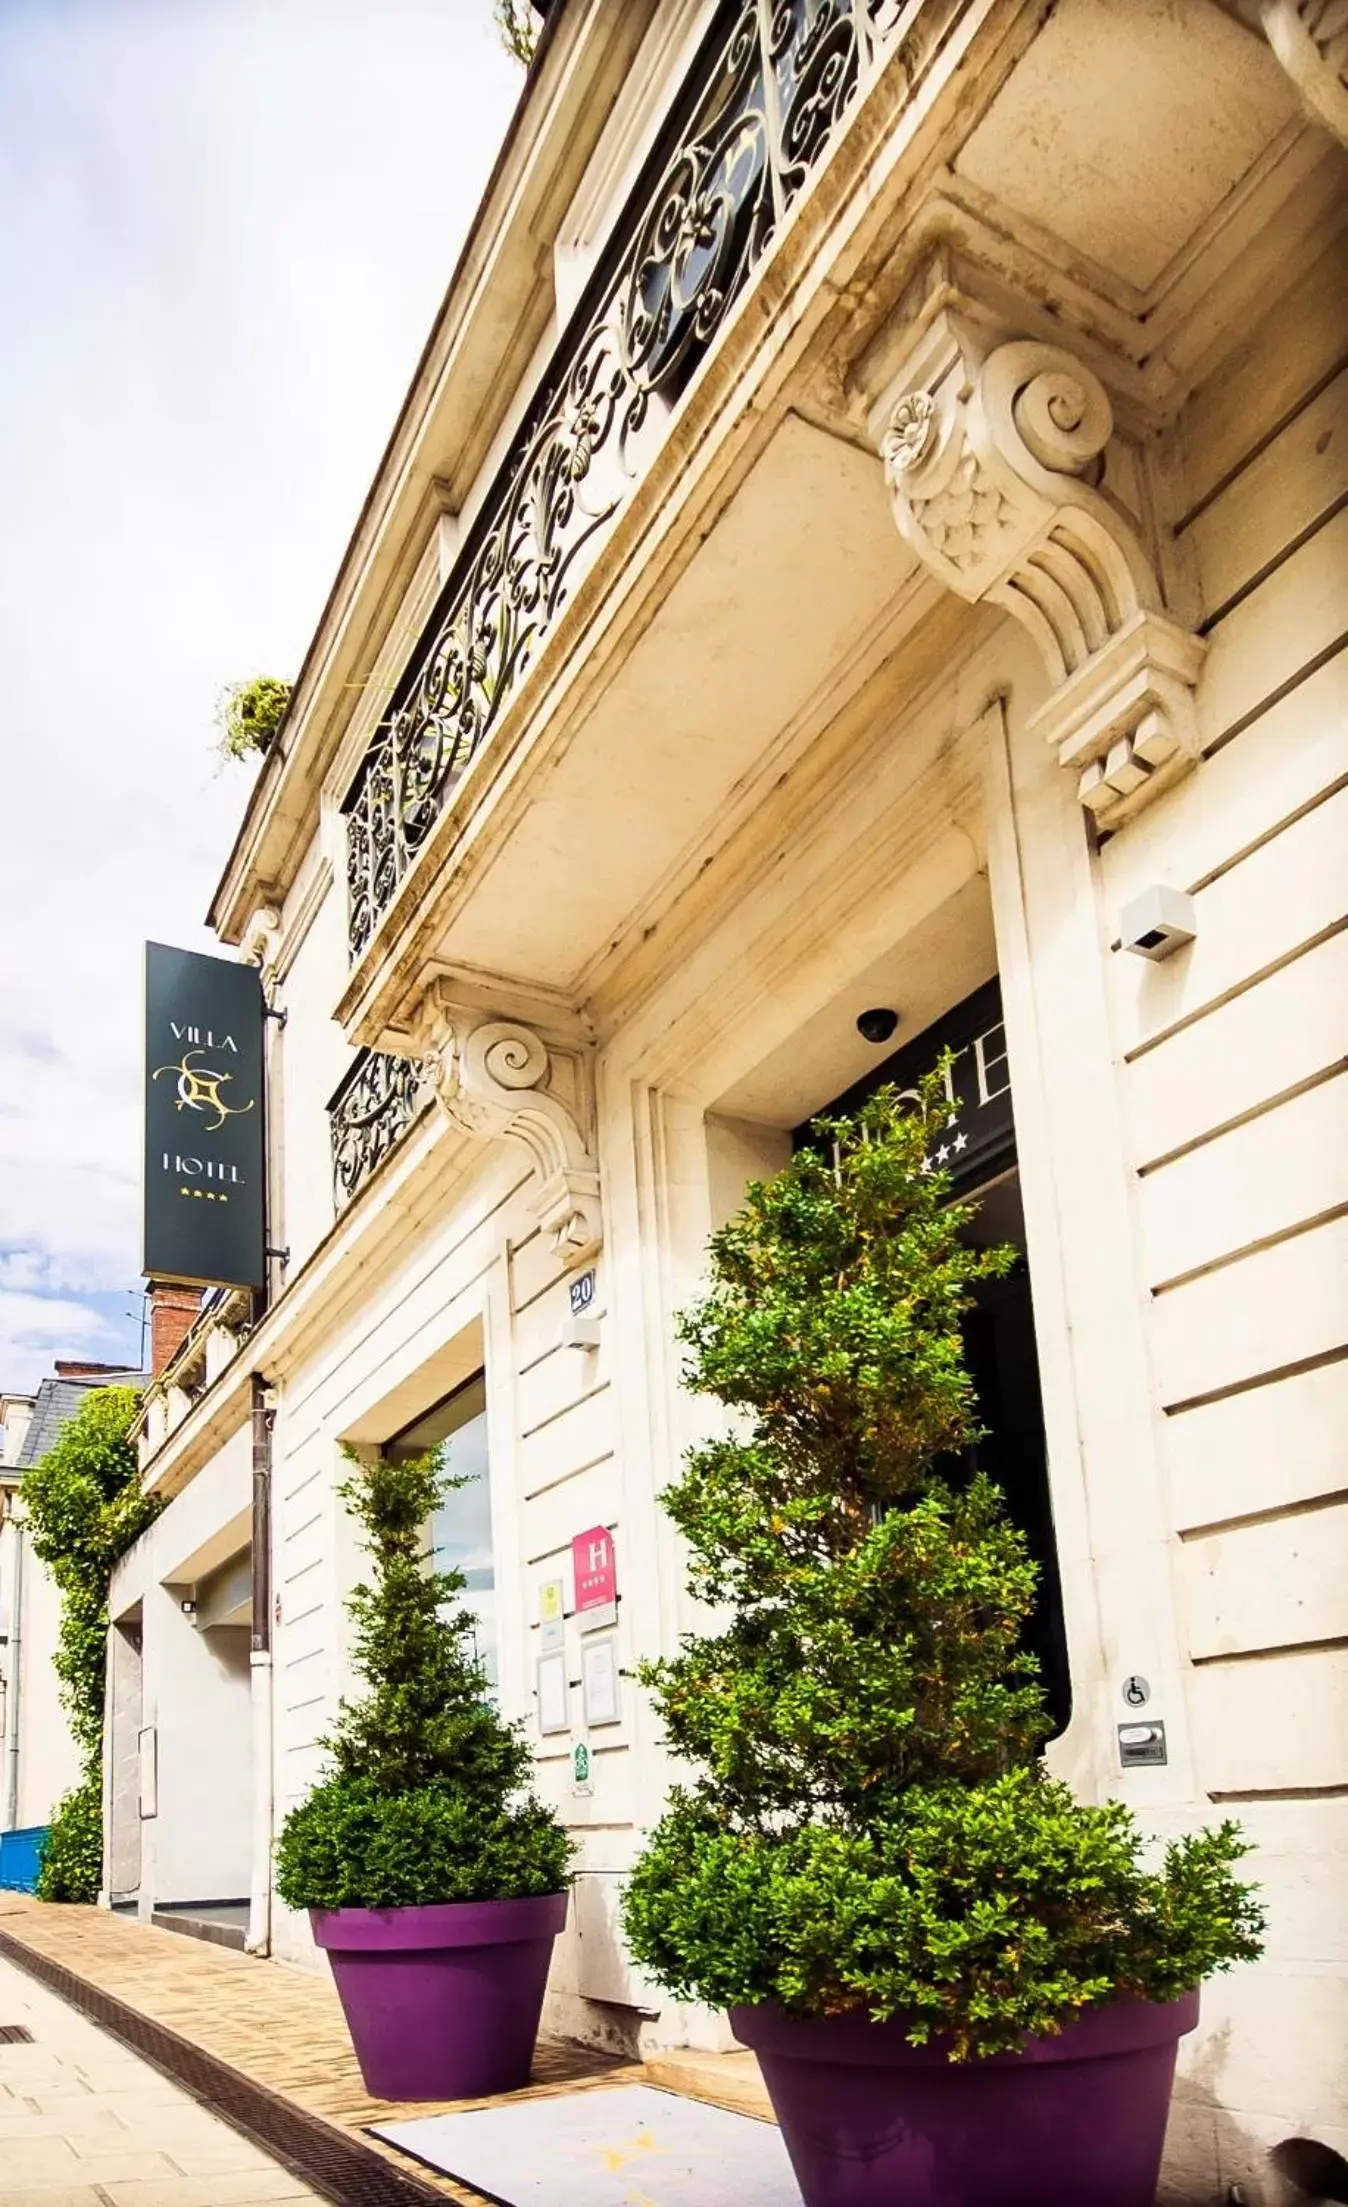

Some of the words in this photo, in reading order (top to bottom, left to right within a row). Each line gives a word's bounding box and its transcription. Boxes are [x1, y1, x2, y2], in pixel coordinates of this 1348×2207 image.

[170, 1021, 238, 1052] VILLA
[163, 1153, 245, 1183] HOTEL
[572, 1278, 591, 1309] 20
[589, 1538, 607, 1569] H
